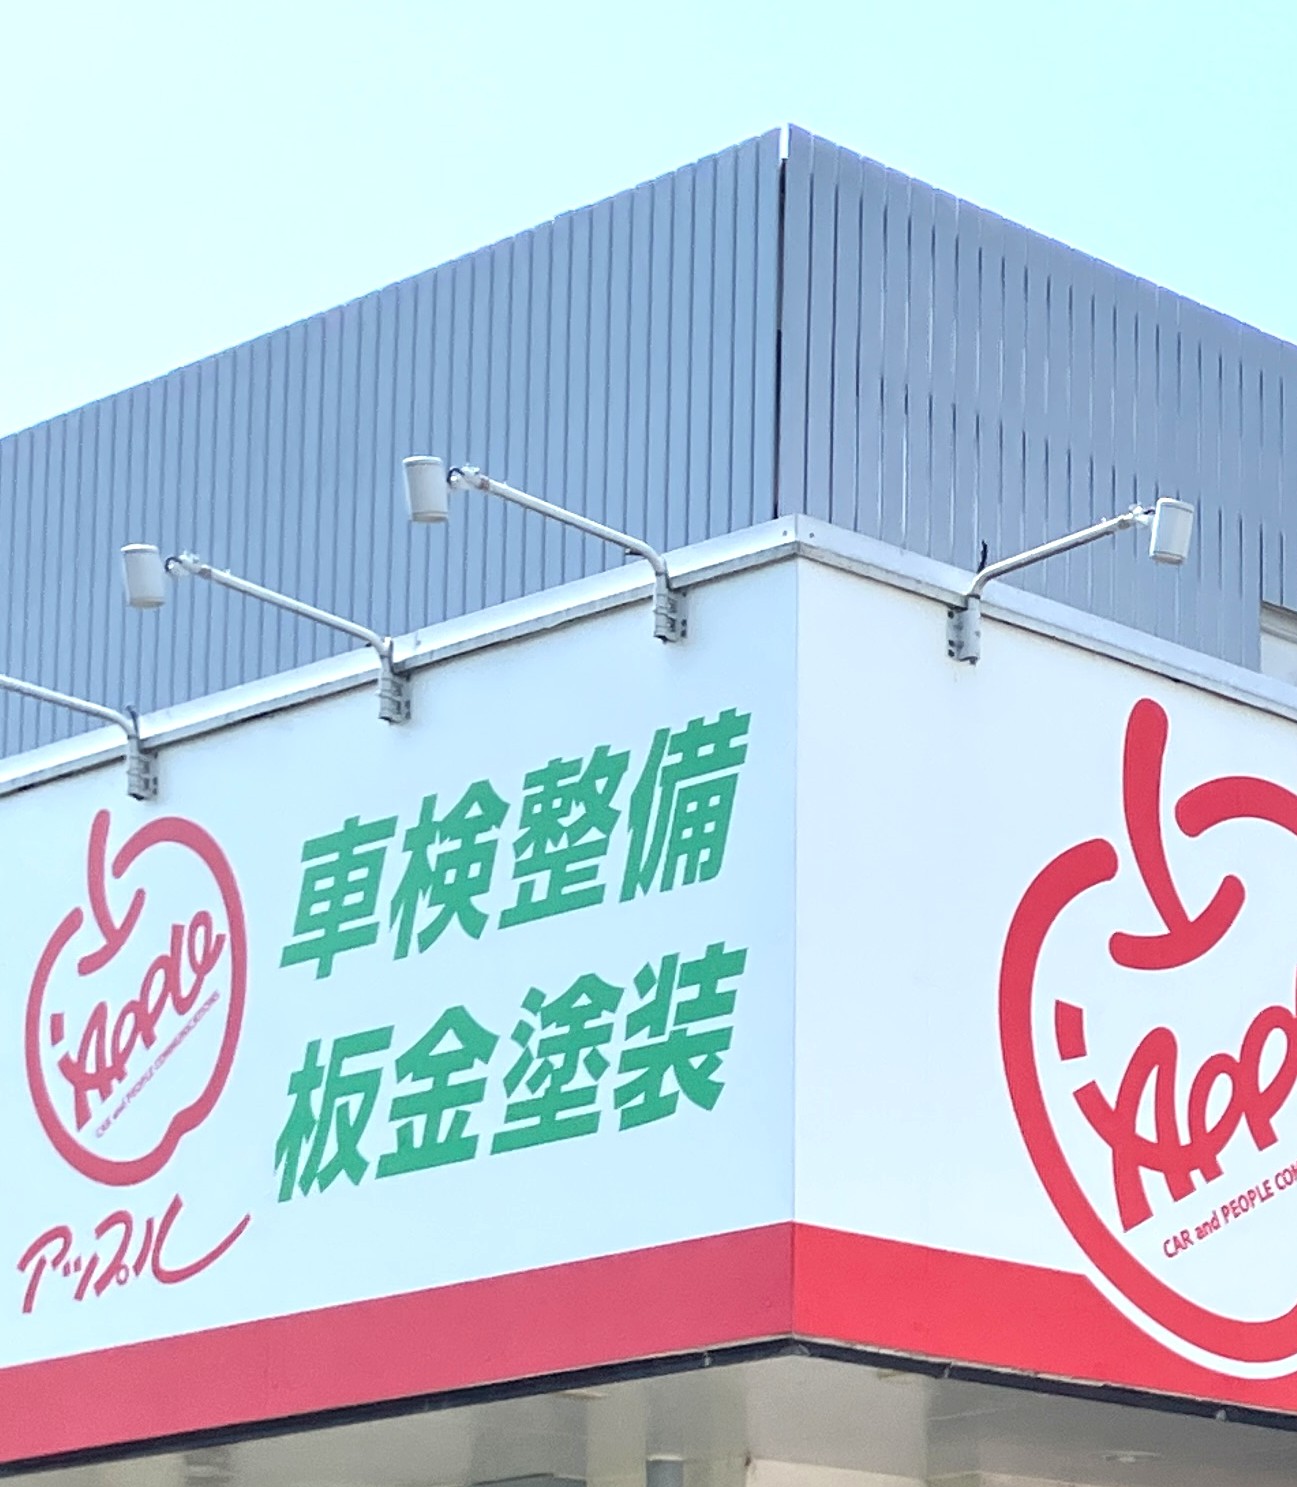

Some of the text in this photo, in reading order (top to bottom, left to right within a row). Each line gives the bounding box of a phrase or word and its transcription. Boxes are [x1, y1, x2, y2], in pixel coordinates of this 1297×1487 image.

[279, 707, 752, 980] 車検整備
[274, 941, 749, 1203] 板金塗装
[17, 1193, 251, 1314] アップル
[1163, 1228, 1194, 1259] CAR
[1195, 1210, 1221, 1240] and
[1221, 1179, 1275, 1225] PEOPLE
